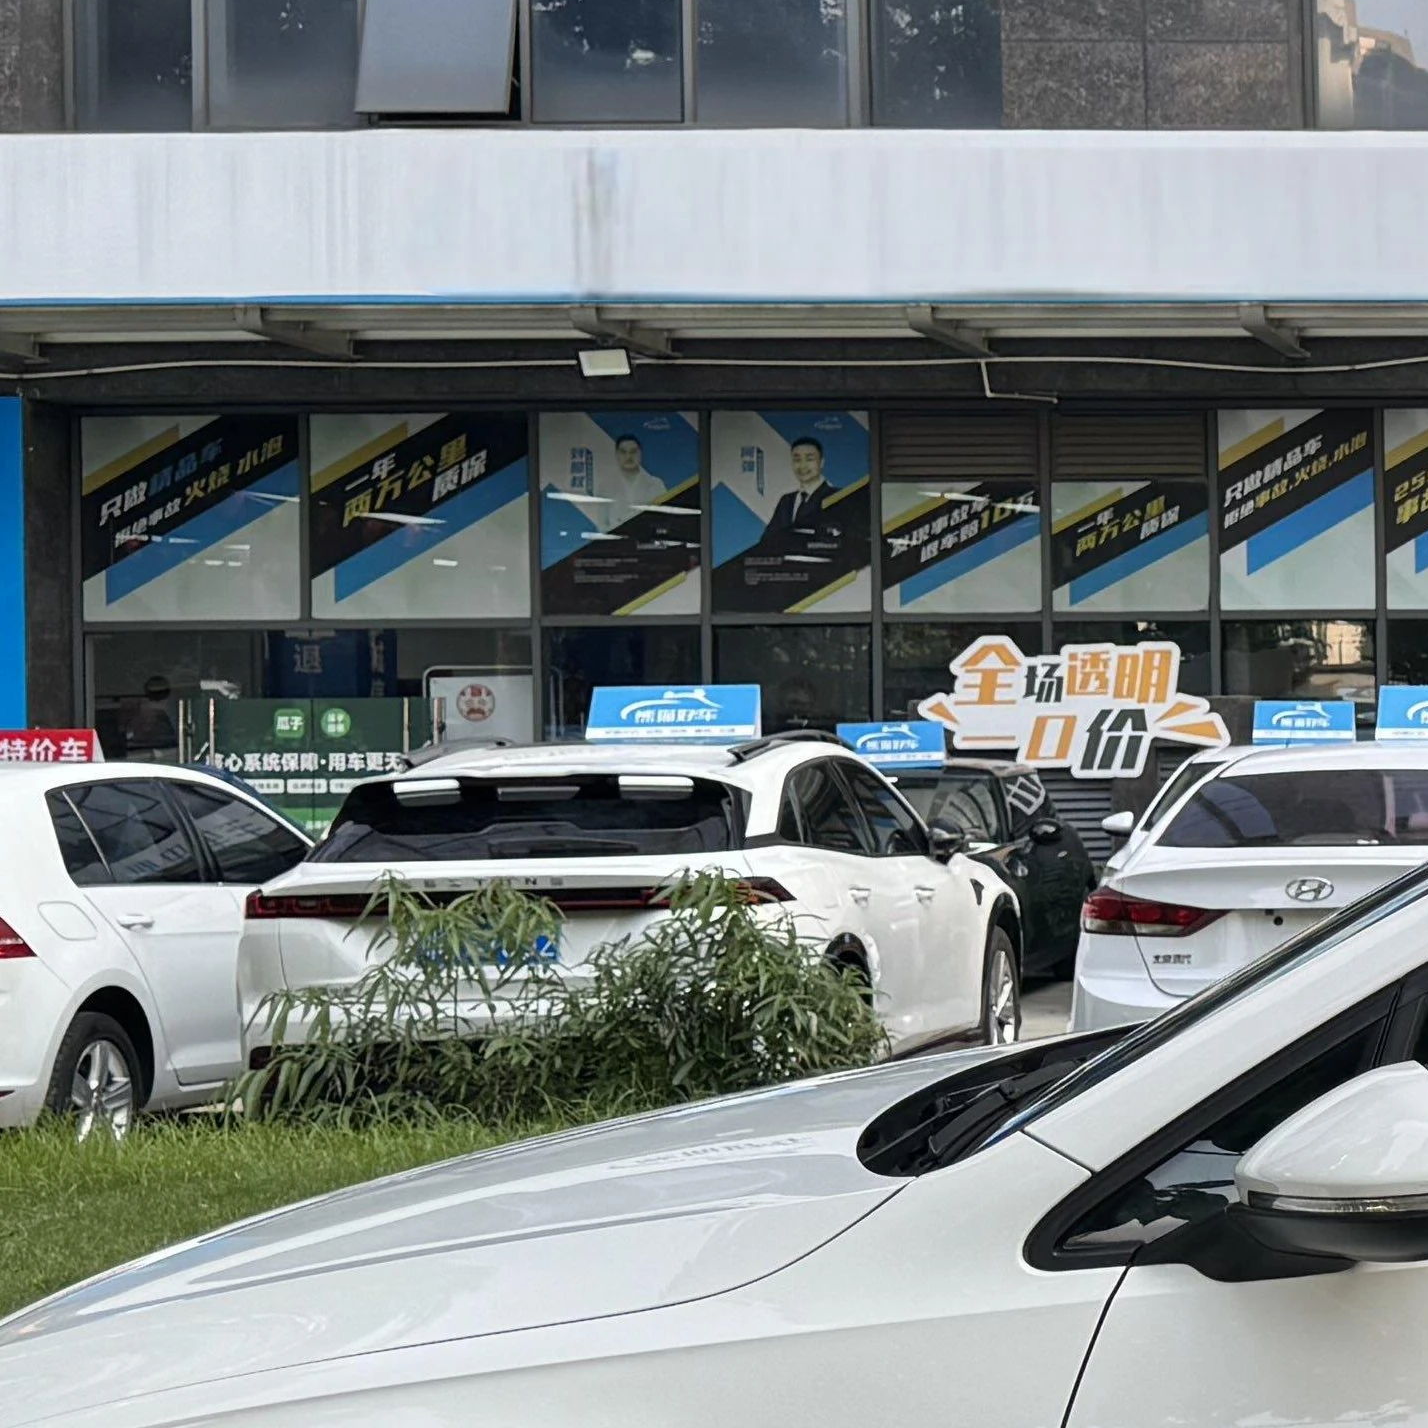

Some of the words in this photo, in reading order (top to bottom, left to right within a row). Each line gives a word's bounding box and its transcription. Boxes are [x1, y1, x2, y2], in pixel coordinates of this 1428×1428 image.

[342, 432, 468, 528] 两万公里
[1223, 433, 1324, 508] 只做精品车
[1075, 495, 1166, 557] 两万公里
[954, 643, 1173, 705] 全场透明
[0, 737, 88, 762] 特价车
[961, 708, 1148, 771] 一口价
